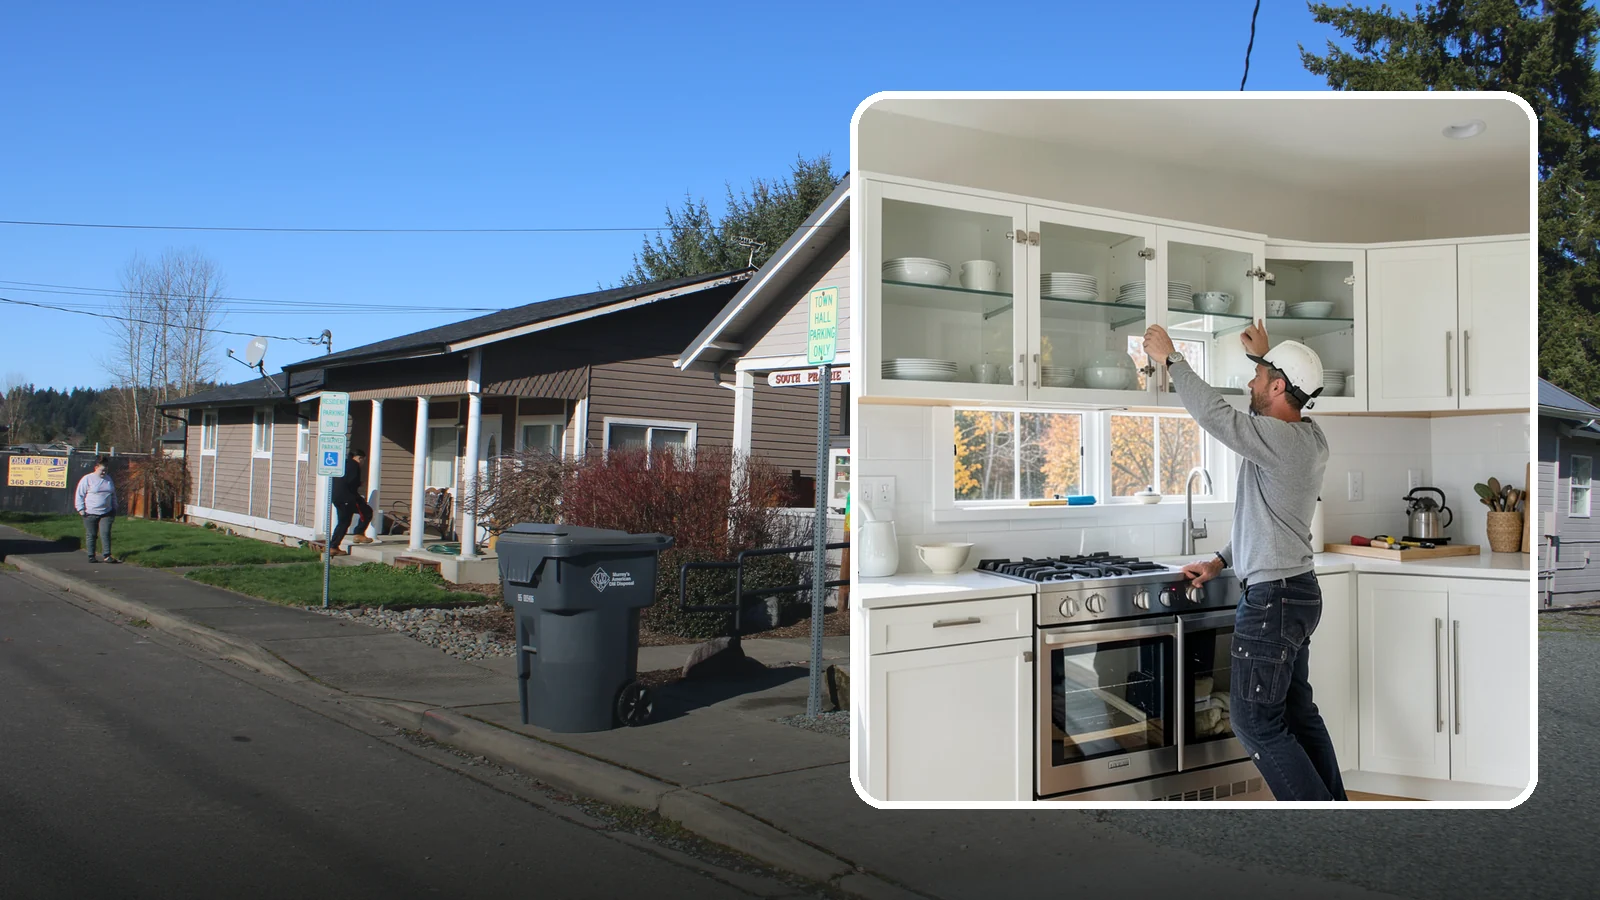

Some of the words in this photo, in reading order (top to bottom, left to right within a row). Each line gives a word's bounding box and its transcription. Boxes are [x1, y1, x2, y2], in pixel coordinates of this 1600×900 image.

[815, 294, 833, 308] TOWN
[814, 311, 831, 324] HALL
[810, 327, 835, 340] PARKING
[813, 344, 831, 357] ONLY
[775, 373, 801, 384] SOUTH
